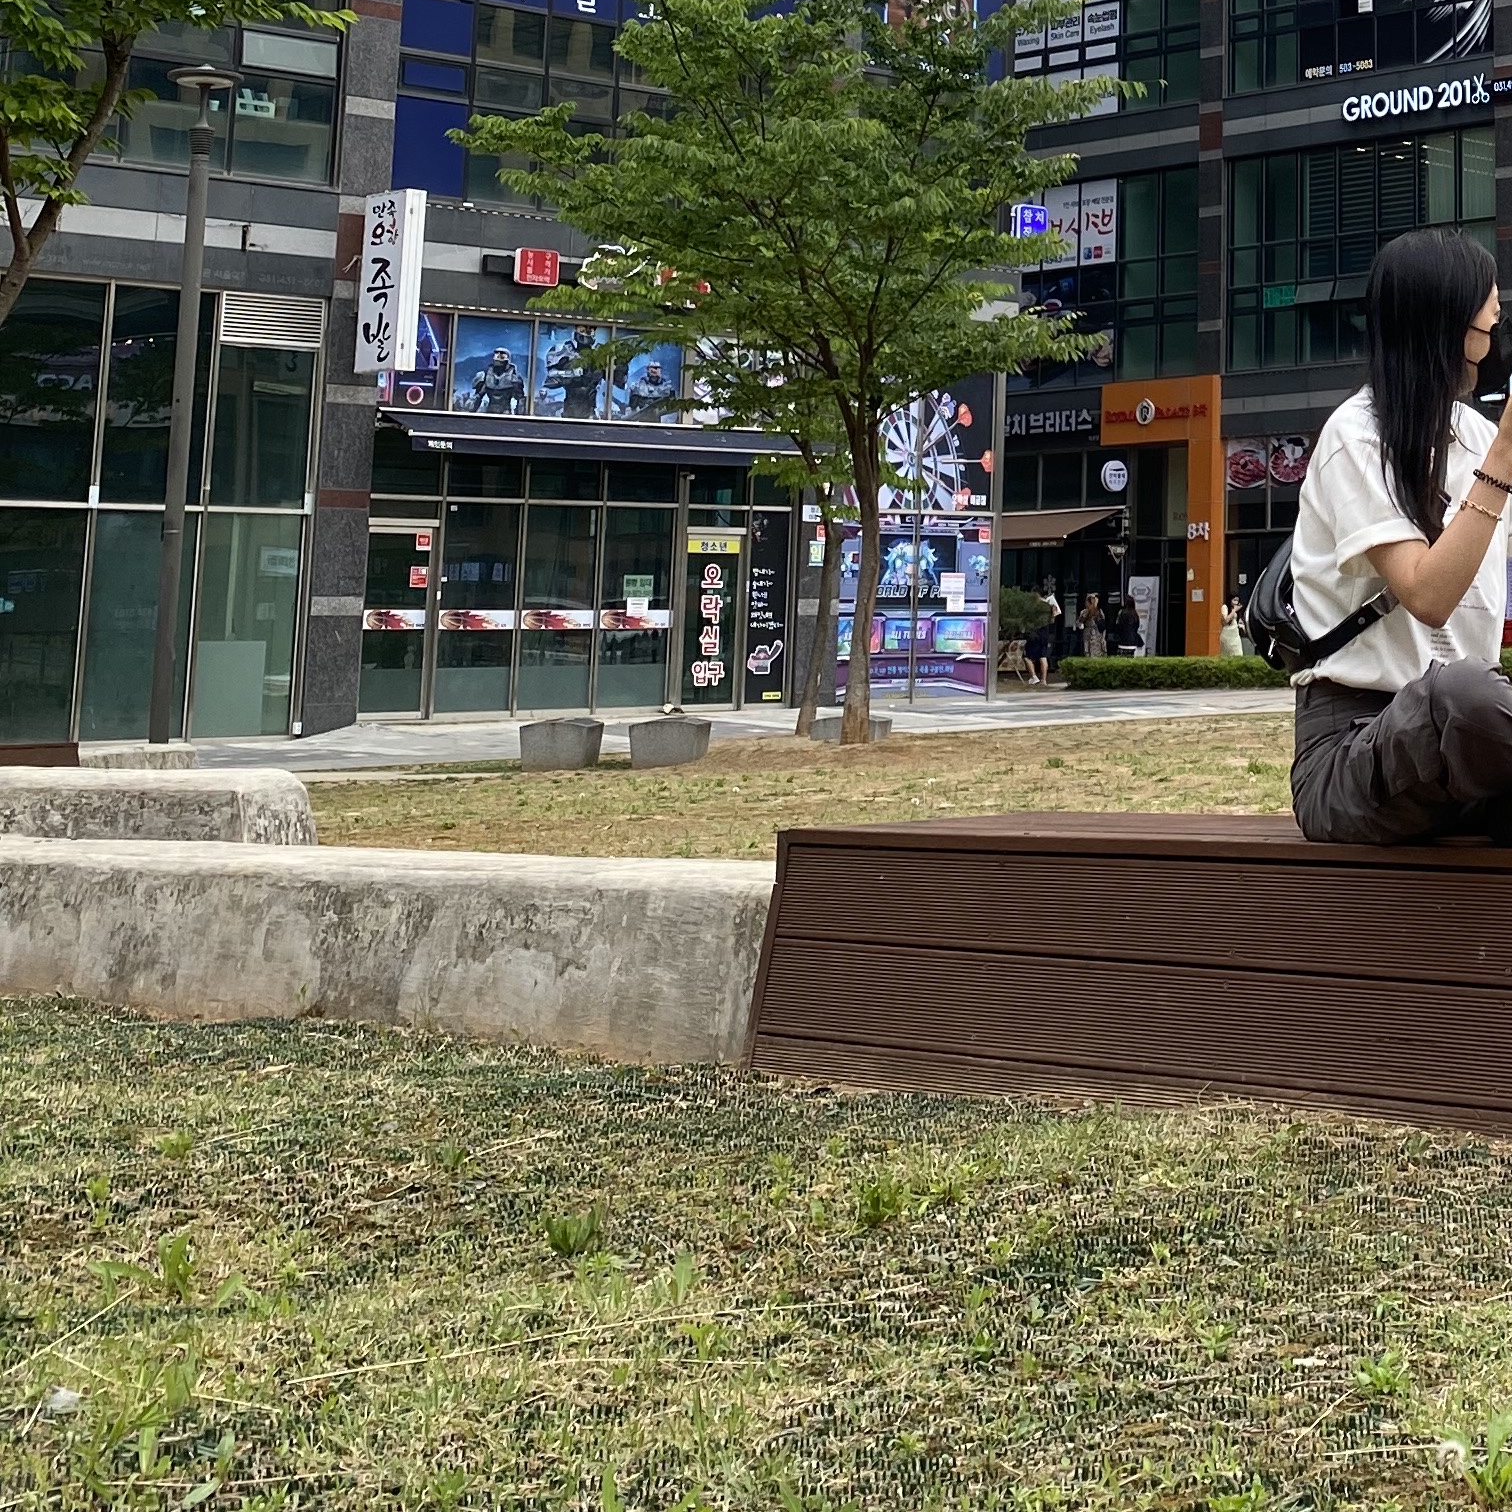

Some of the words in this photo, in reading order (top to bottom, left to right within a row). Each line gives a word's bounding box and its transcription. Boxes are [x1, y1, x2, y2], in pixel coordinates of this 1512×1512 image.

[1342, 85, 1434, 122] GROUND
[1438, 79, 1471, 108] 201
[1023, 208, 1045, 226] 참치
[362, 257, 396, 364] 족발
[1187, 522, 1210, 541] 8차
[700, 541, 728, 552] 청소년
[876, 584, 909, 598] ORLD
[699, 564, 724, 656] 오락실
[692, 661, 725, 687] 입구
